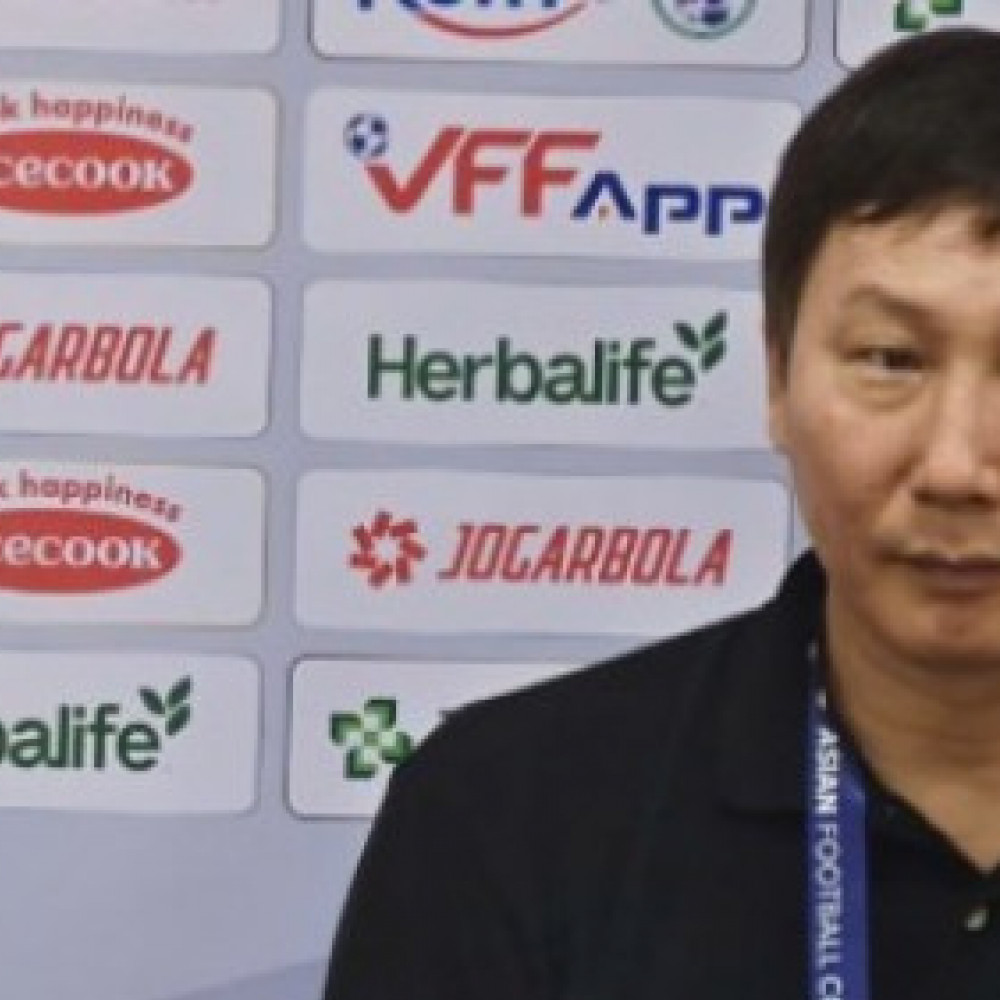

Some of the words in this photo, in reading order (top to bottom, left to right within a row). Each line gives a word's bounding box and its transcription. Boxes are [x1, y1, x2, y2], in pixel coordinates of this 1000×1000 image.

[29, 88, 194, 142] happiness
[367, 333, 696, 408] Herbalife
[18, 467, 184, 523] happiness
[436, 522, 735, 587] JOGARBOLA
[815, 724, 840, 815] ASIAN
[815, 823, 842, 970] FOOTBALL
